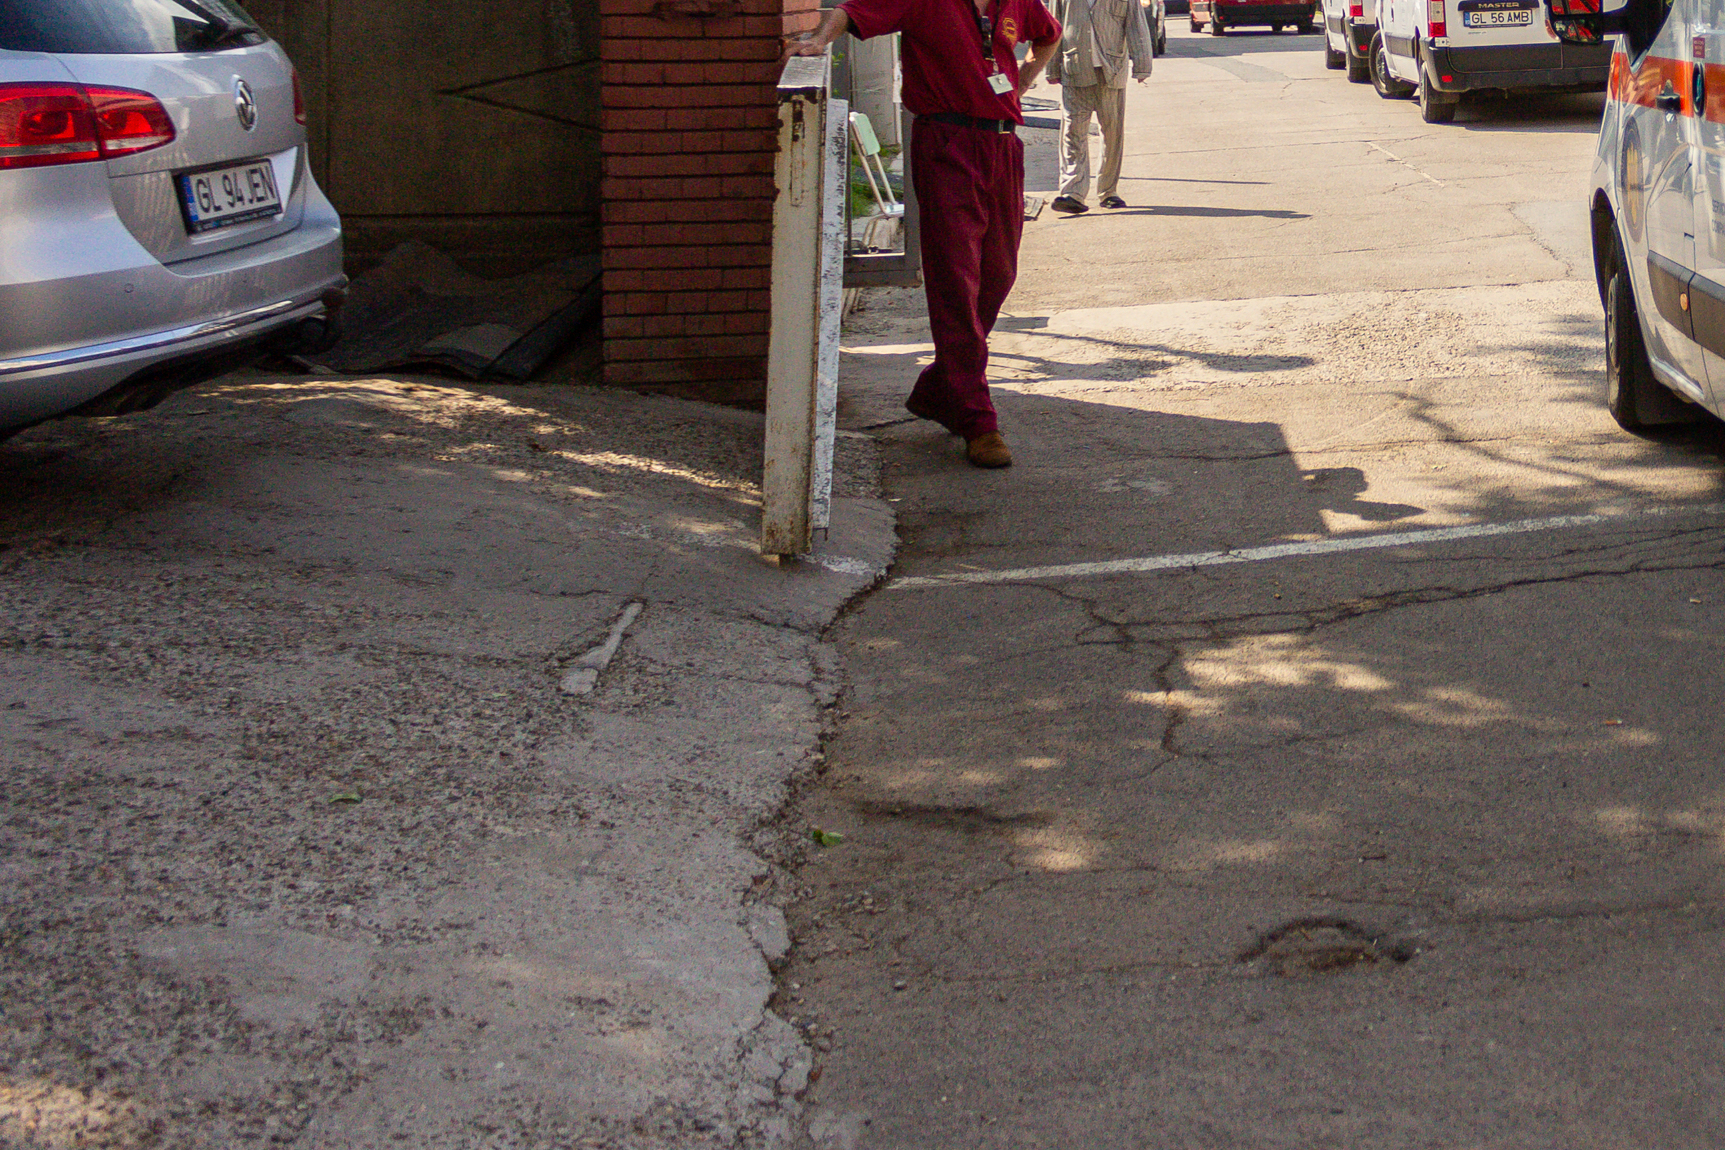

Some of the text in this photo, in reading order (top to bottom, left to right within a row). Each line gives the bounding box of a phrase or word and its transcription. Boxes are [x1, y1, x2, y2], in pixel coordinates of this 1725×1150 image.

[1478, 1, 1520, 9] MASTER
[1471, 13, 1487, 24] GL
[1491, 12, 1505, 23] 56
[1507, 11, 1530, 22] AMB
[196, 177, 223, 213] GL
[222, 172, 246, 208] 94
